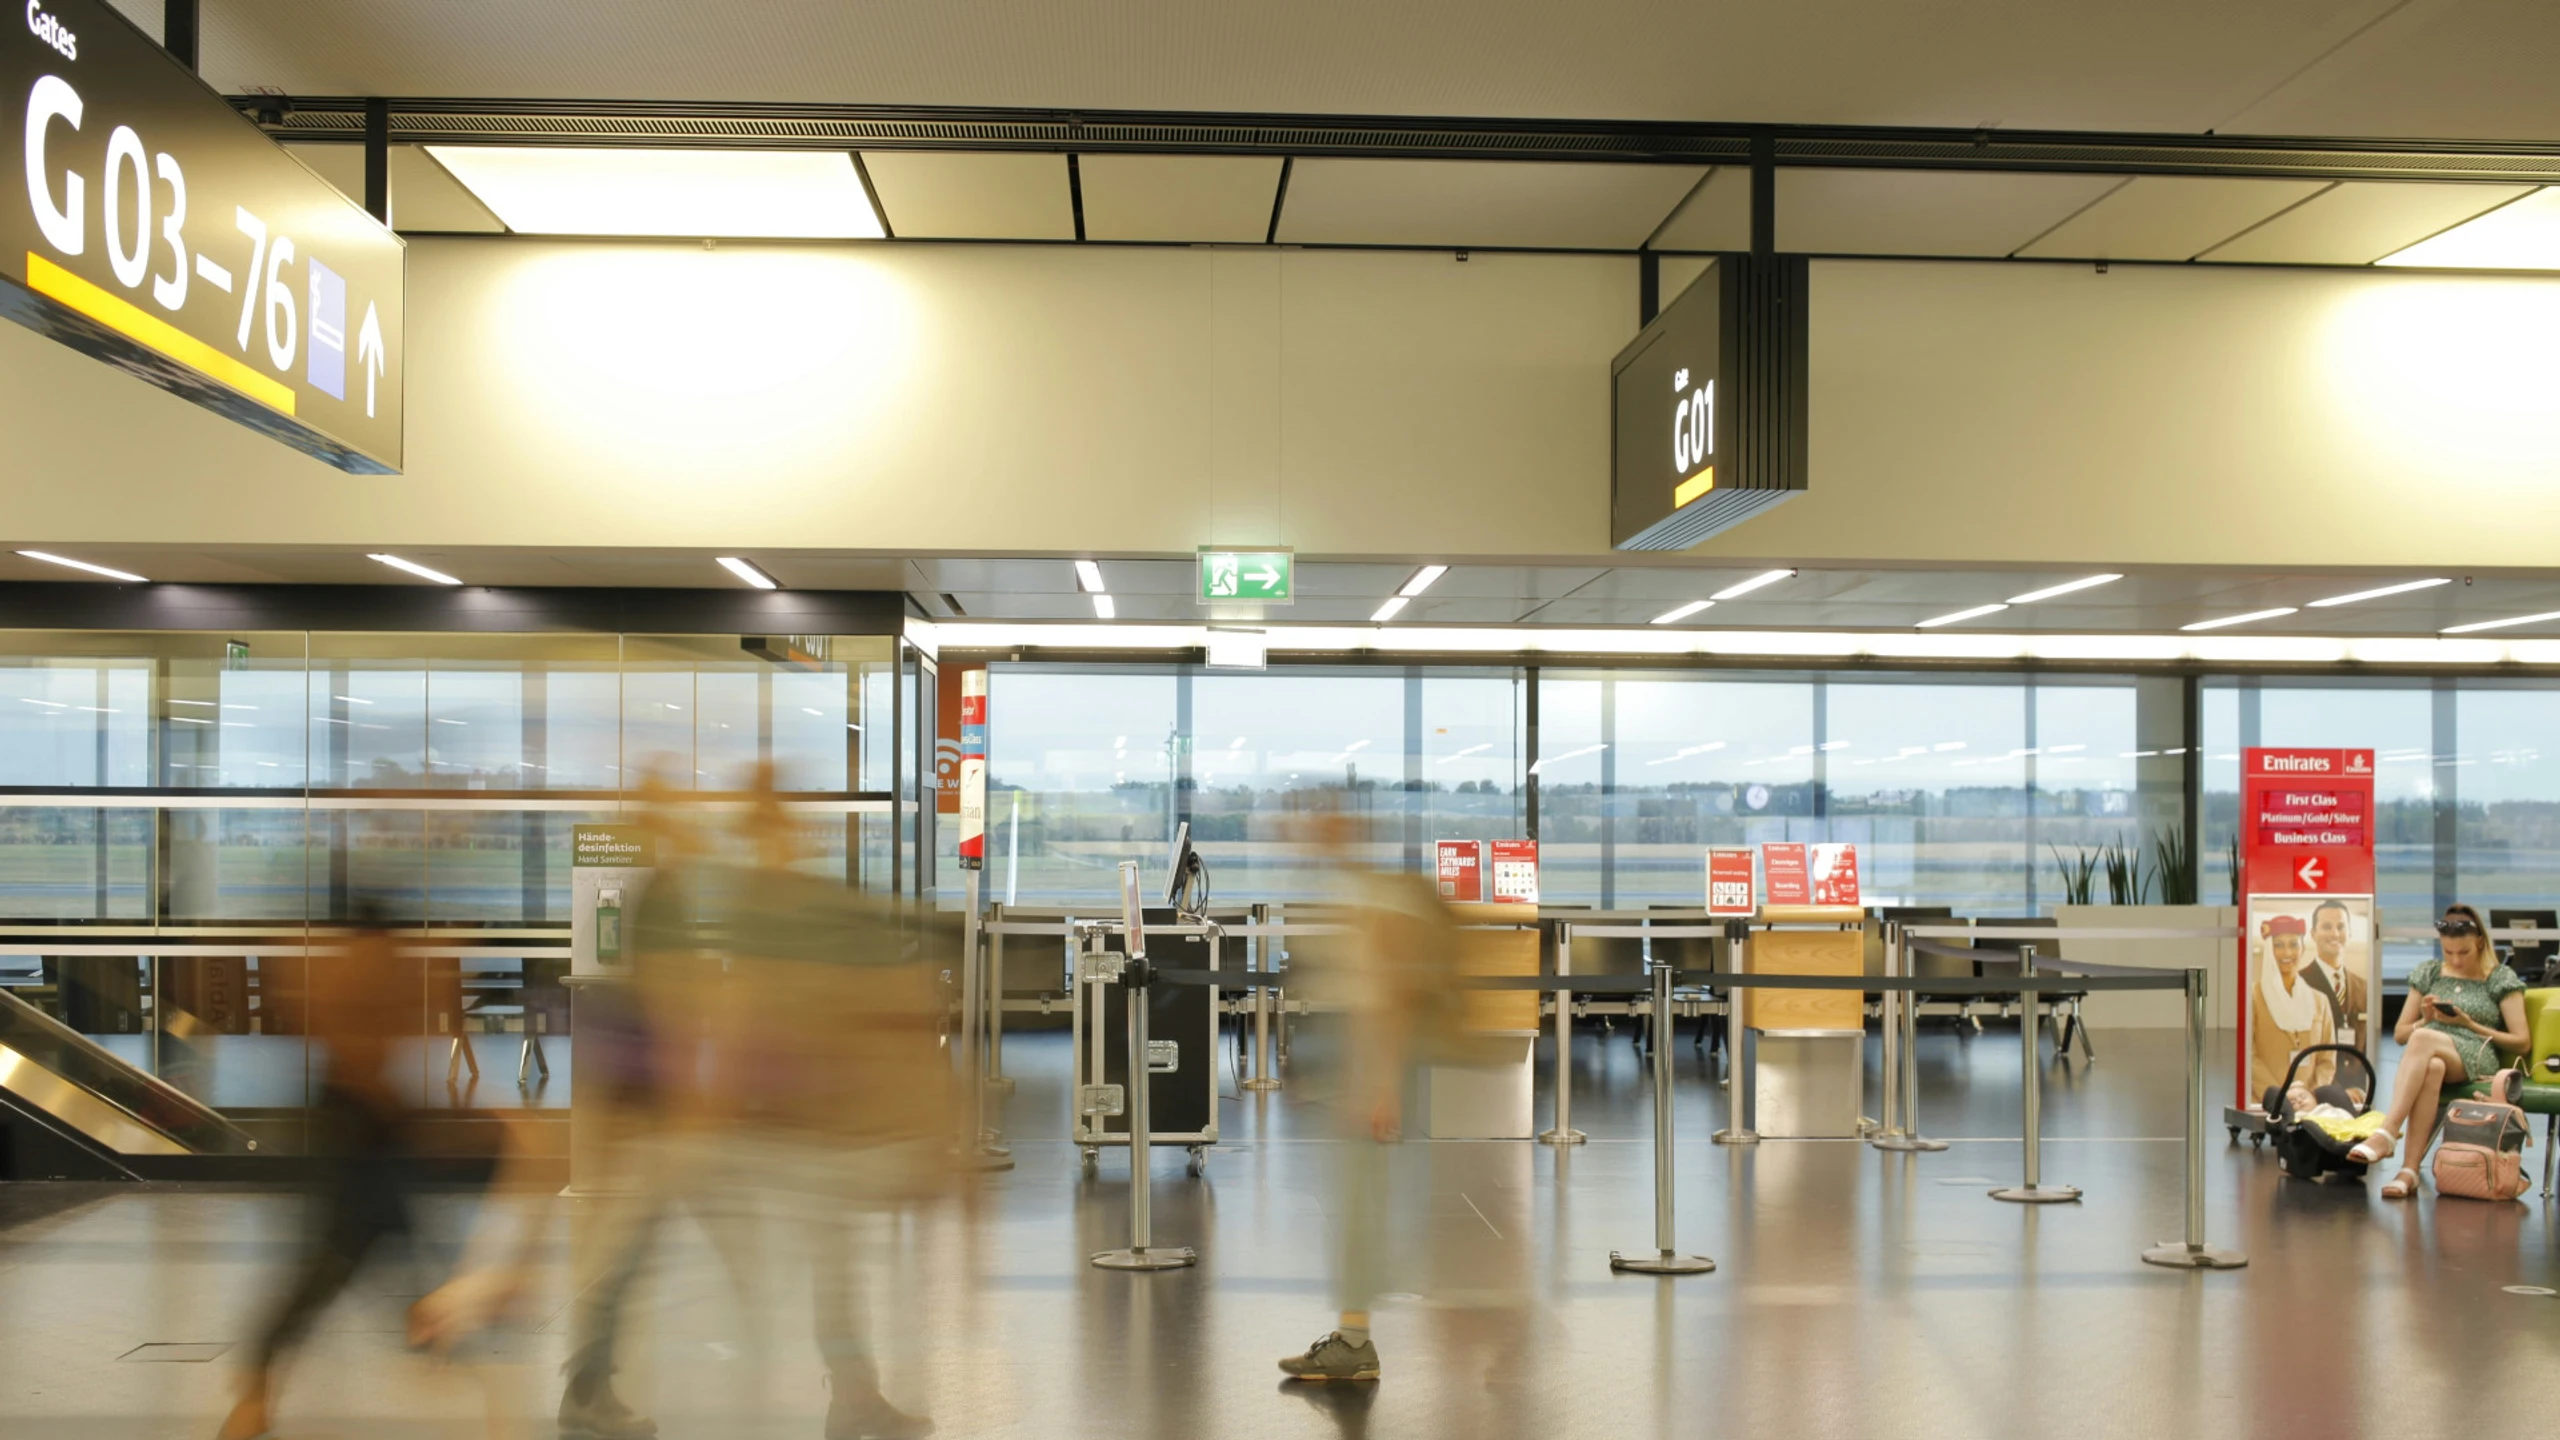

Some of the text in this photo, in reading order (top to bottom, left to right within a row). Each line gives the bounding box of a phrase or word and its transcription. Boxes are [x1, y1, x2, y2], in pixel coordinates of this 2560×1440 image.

[27, 0, 77, 61] Gates
[2263, 754, 2331, 772] Emirates
[2285, 794, 2338, 806] First Class
[2261, 812, 2360, 825] Platinum/Gold/Silver
[578, 832, 616, 841] Hände-
[2274, 832, 2347, 844] Business Class
[578, 842, 642, 854] desinfektion
[1440, 847, 1457, 857] EARN
[578, 855, 633, 864] Hand Sanitizer
[1440, 857, 1476, 867] SKYWARDS
[1440, 867, 1460, 876] MILES
